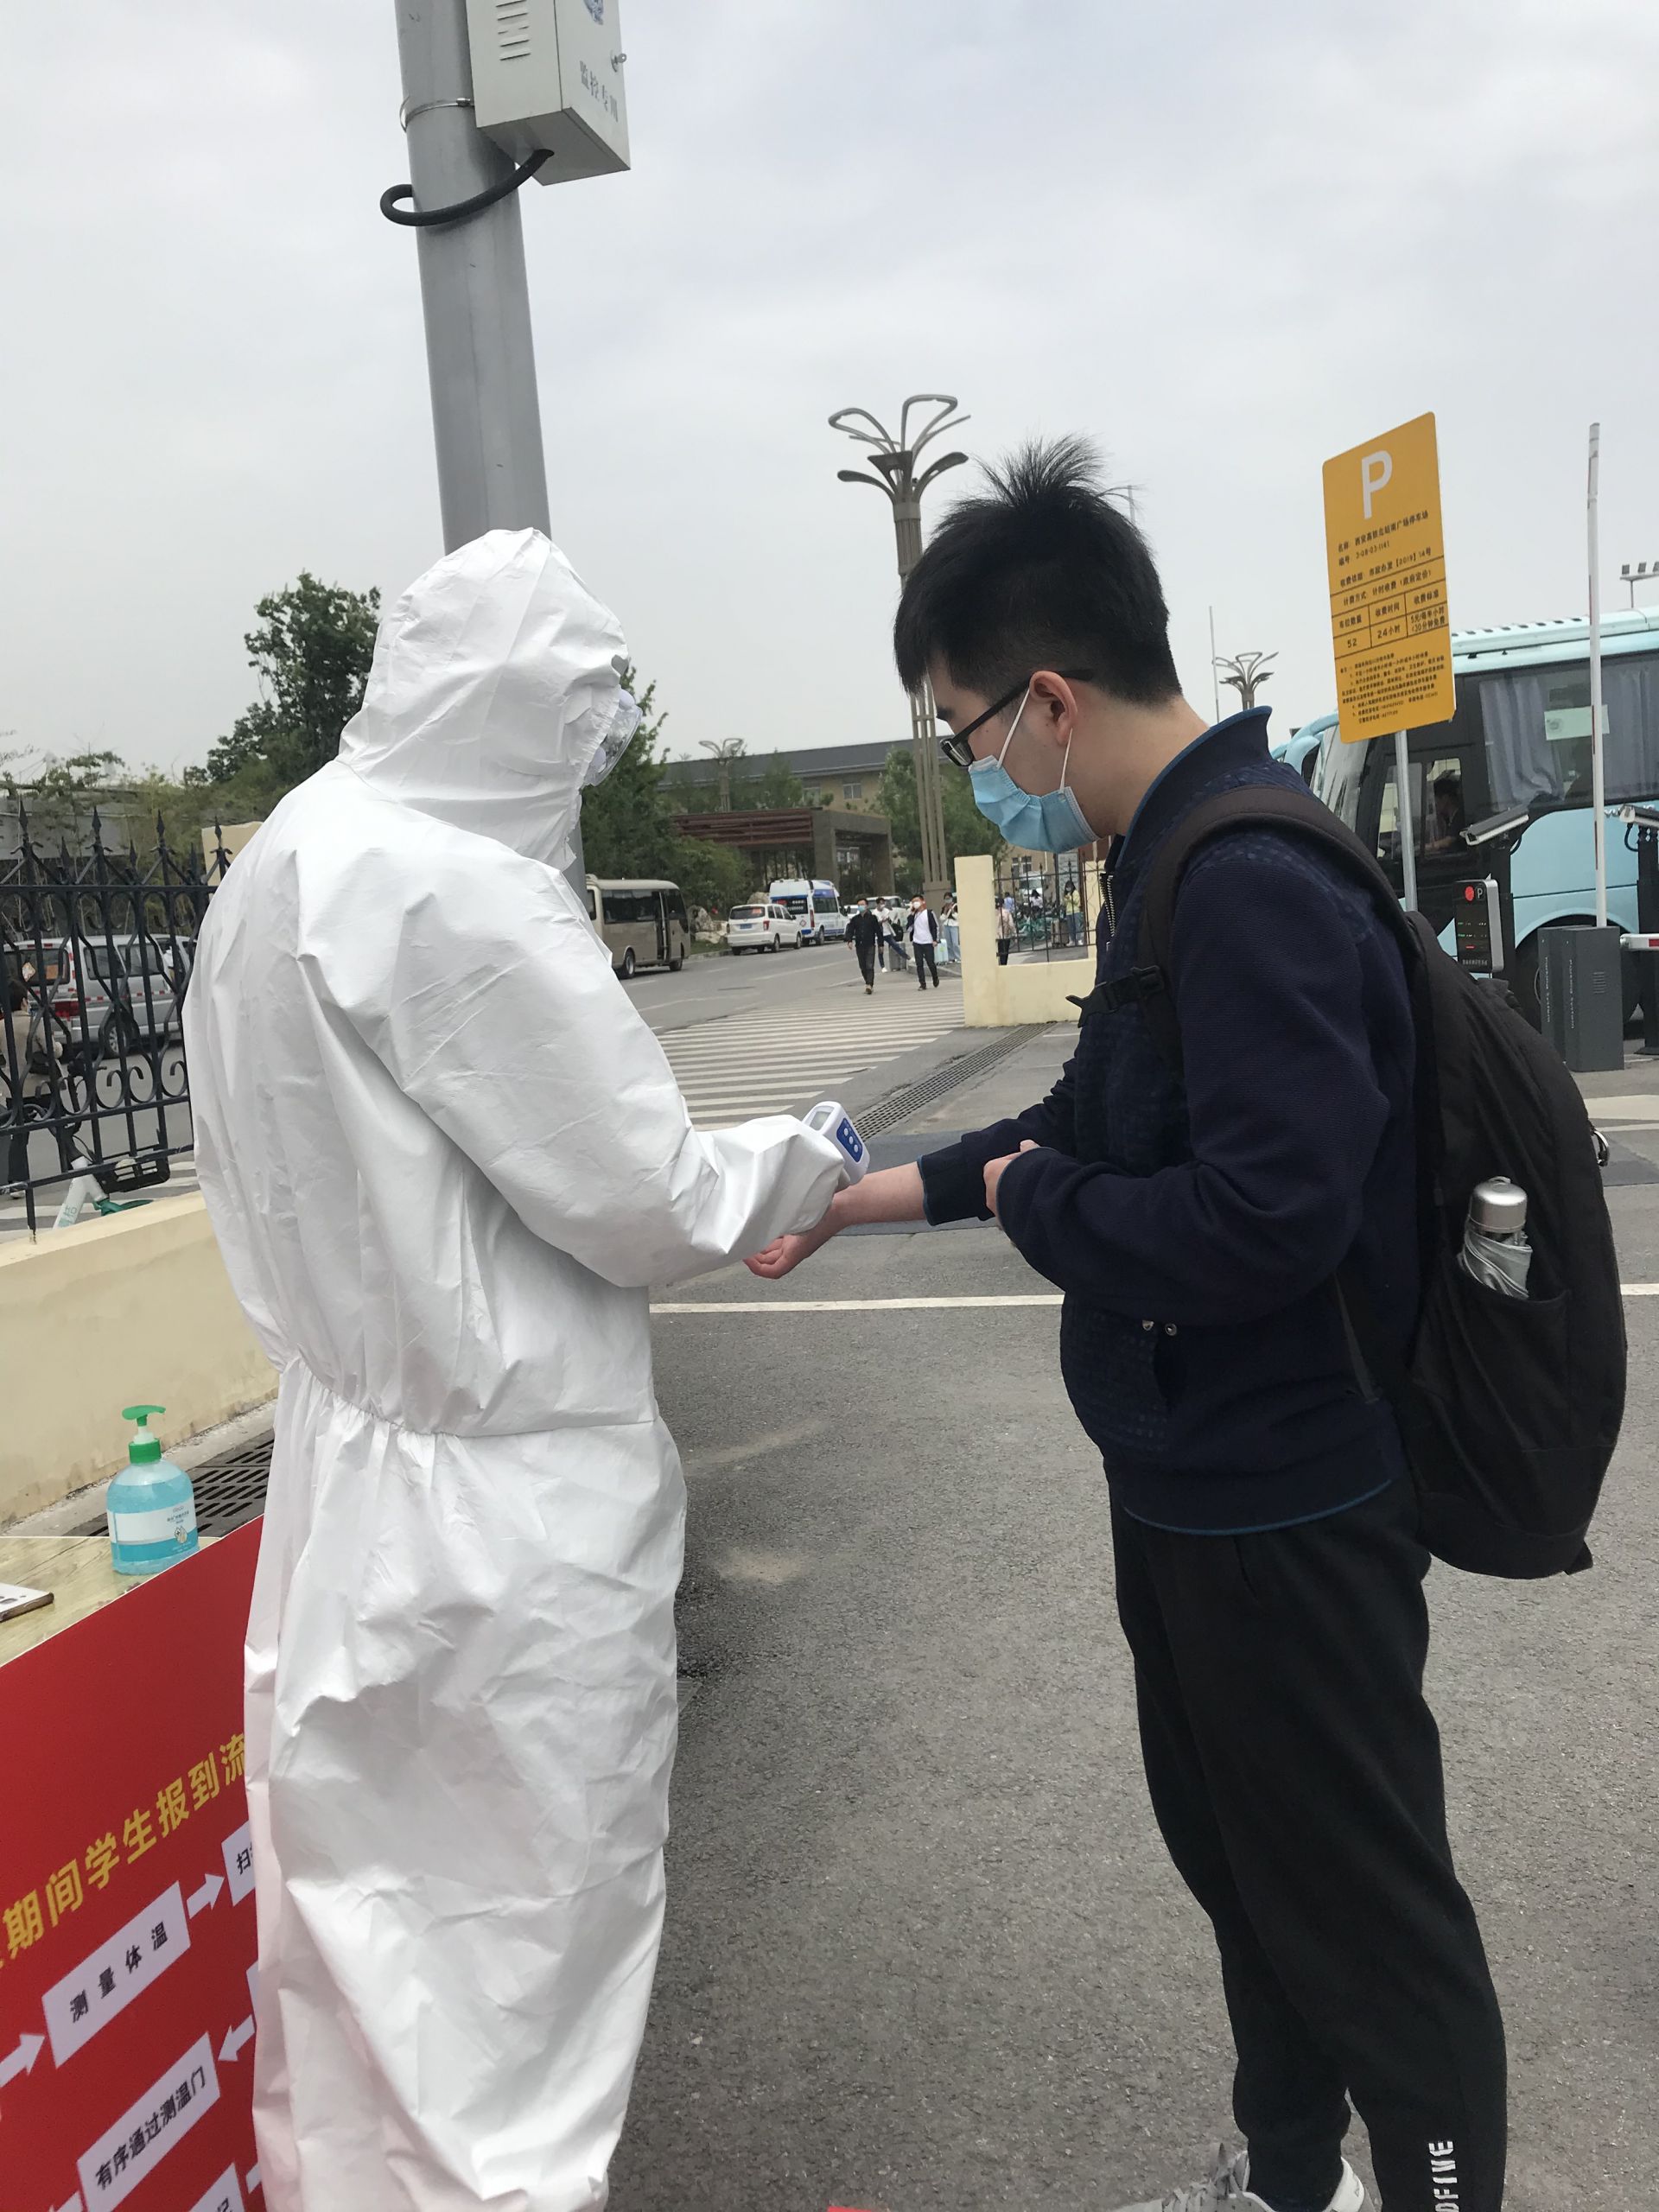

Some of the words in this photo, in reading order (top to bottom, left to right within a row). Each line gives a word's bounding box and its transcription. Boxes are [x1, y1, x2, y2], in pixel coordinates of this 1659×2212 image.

[1361, 450, 1393, 519] P
[1347, 638, 1357, 648] 52
[1376, 625, 1401, 639] 24小时
[1477, 887, 1484, 899] P
[0, 1732, 245, 1969] 期间学生报到流
[236, 1841, 254, 1875] 扫
[70, 1922, 168, 2023] 测量体温
[95, 2066, 206, 2190] 有序通过测温门
